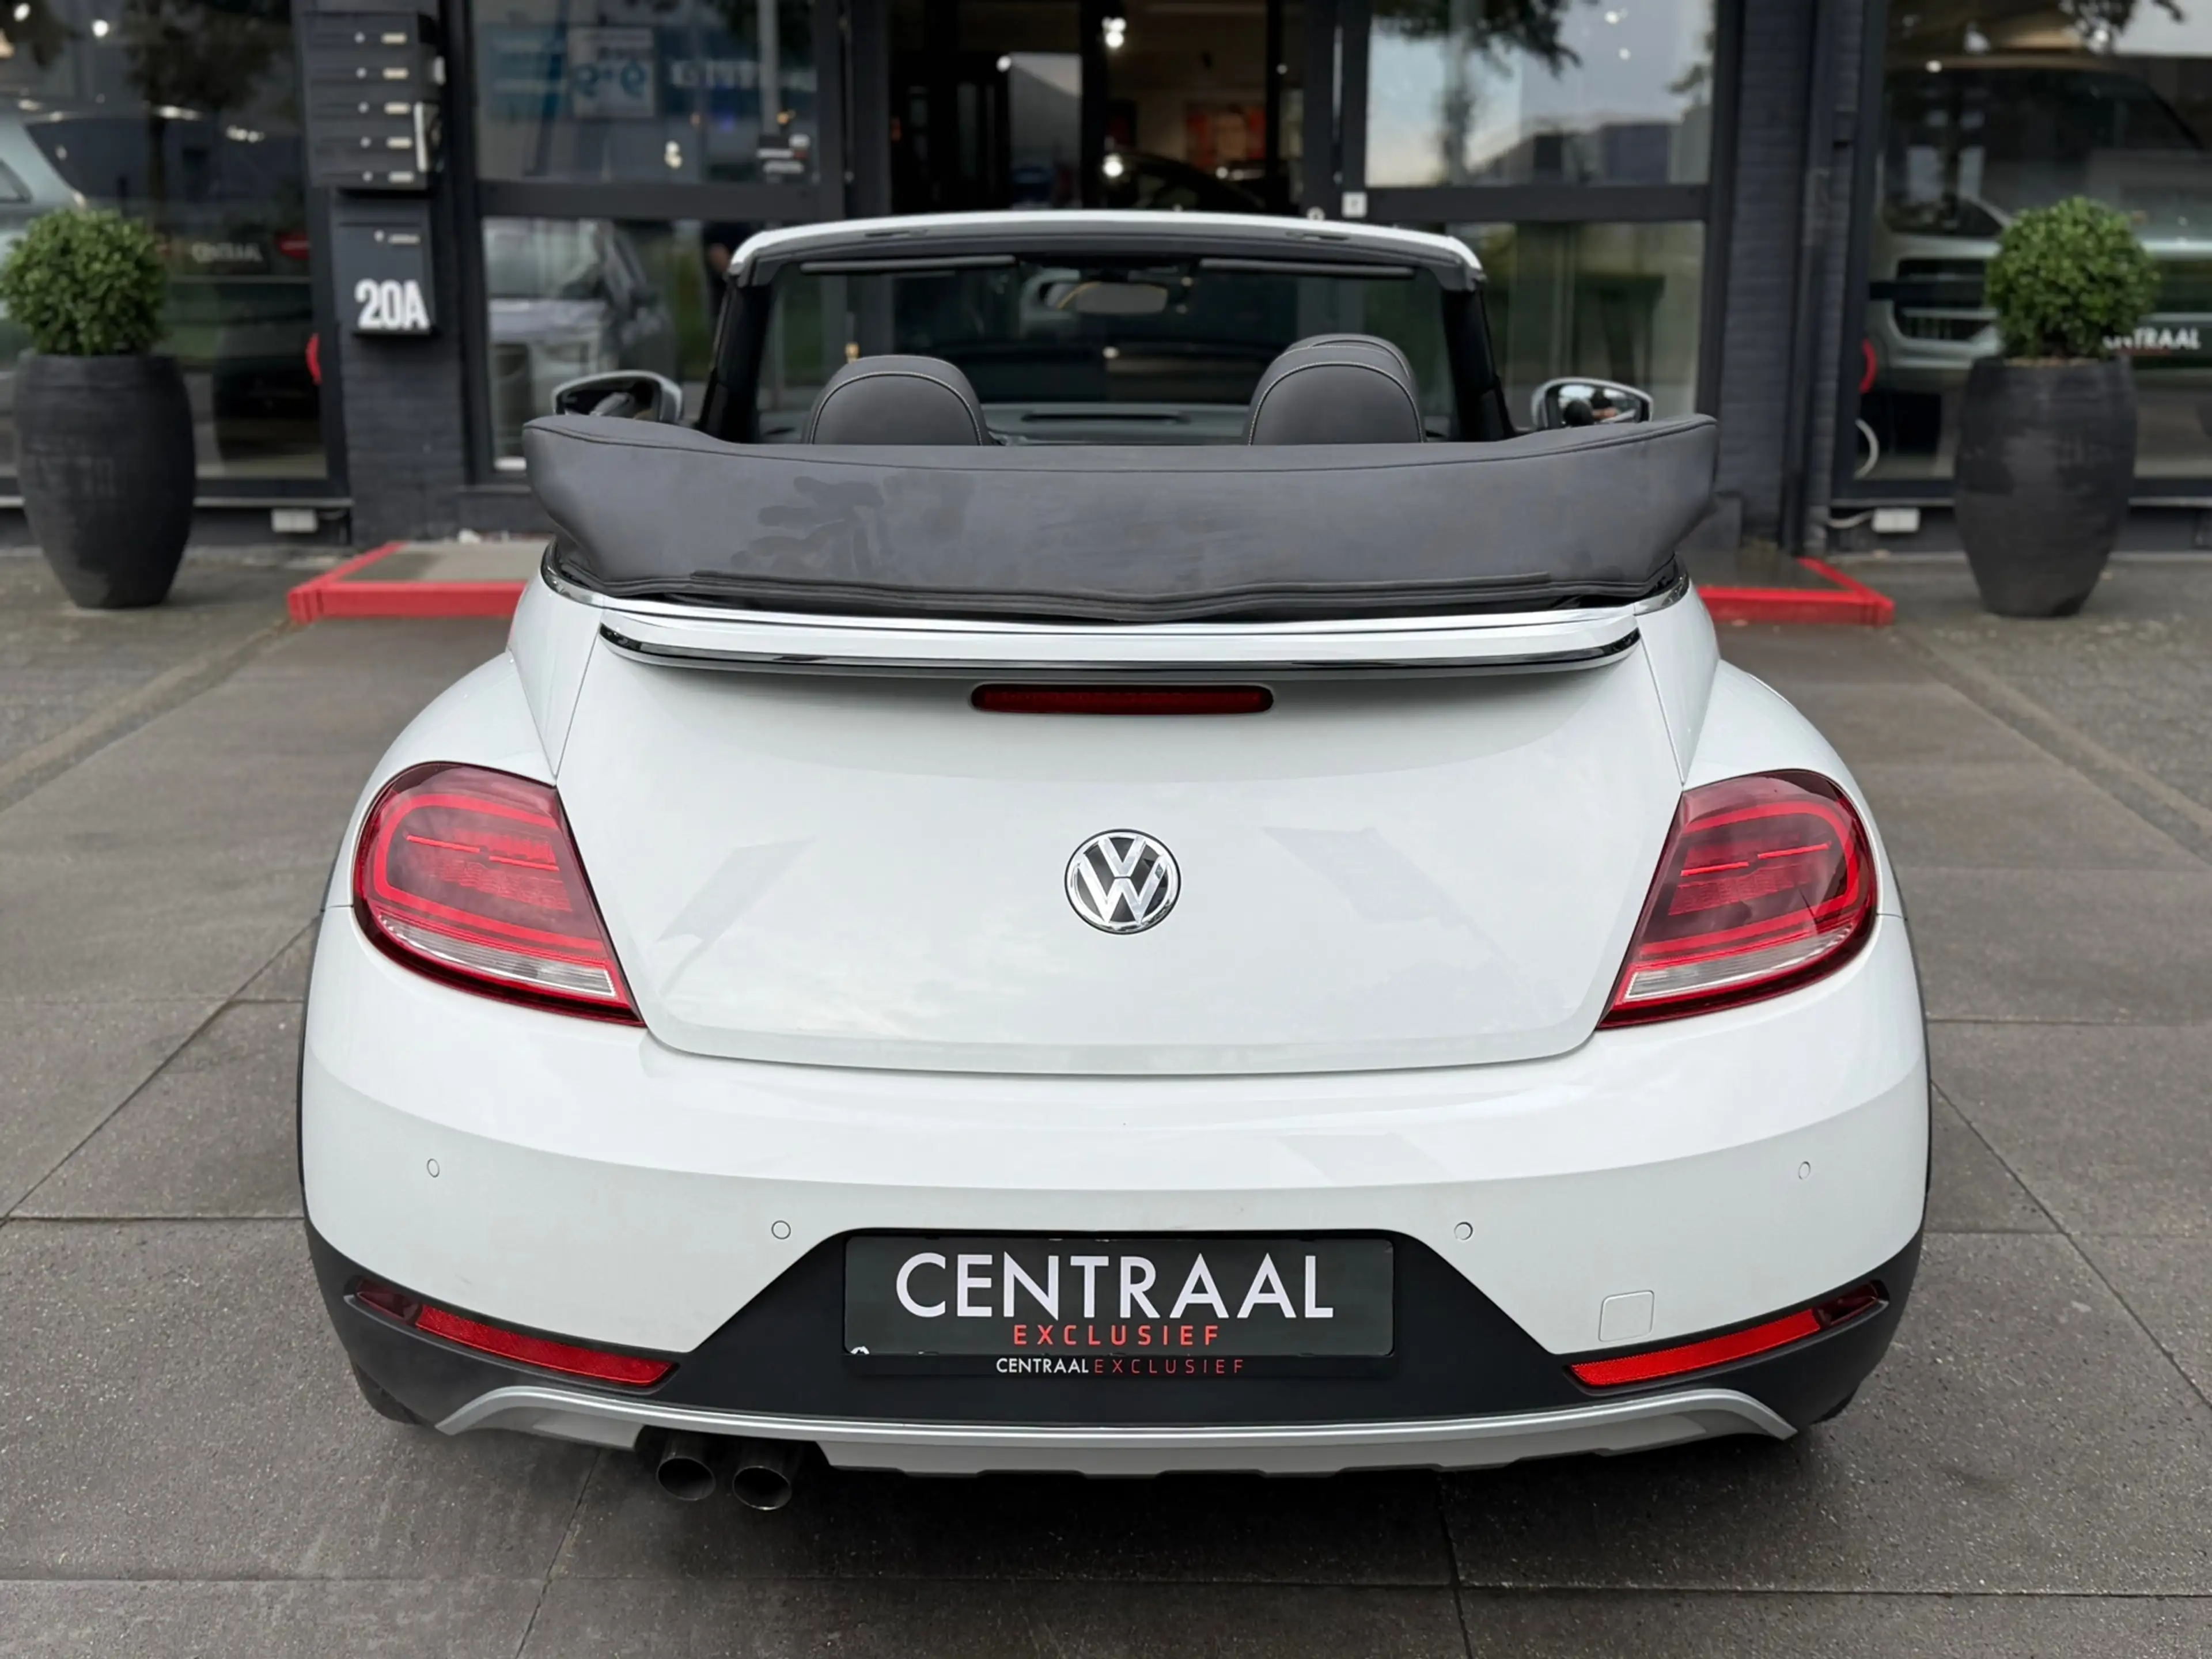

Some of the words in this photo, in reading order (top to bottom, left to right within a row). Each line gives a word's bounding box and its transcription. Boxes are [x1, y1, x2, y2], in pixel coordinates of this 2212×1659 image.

[354, 278, 430, 329] 20A
[896, 1251, 1334, 1321] CENTRAAL
[1013, 1324, 1218, 1347] EXCLUSIEF
[995, 1357, 1089, 1374] CENTRAAL
[1094, 1359, 1242, 1374] EXCLUSIEF
